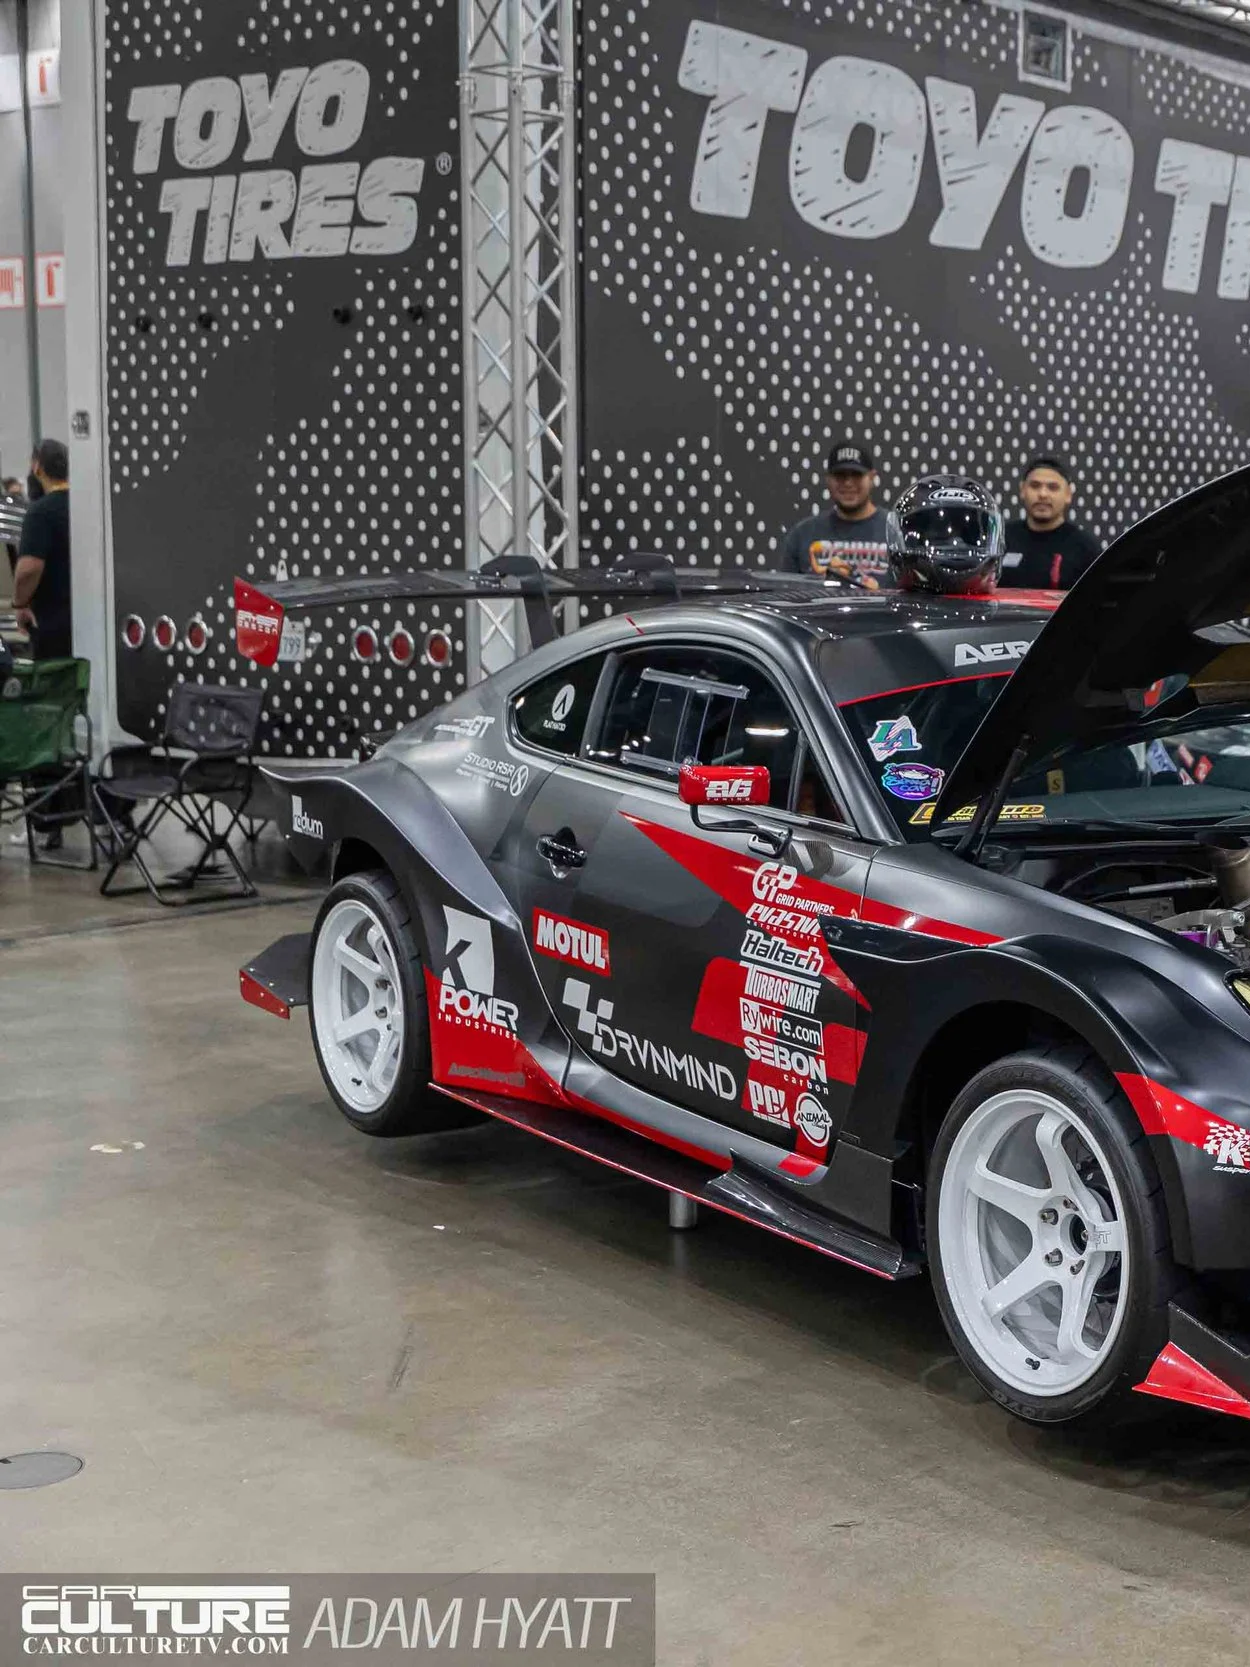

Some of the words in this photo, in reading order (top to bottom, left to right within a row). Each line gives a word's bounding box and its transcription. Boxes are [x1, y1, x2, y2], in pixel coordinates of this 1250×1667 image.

[126, 59, 371, 174] TOYO
[678, 20, 1134, 269] TOYO
[158, 157, 424, 267] TIRES
[937, 490, 972, 501] HJC
[464, 752, 496, 770] STUDIO
[496, 761, 516, 777] RSR
[776, 893, 795, 907] GRID
[794, 898, 835, 916] PARTNERS
[536, 914, 606, 970] MOTUL
[741, 929, 824, 977] Haltech
[439, 984, 519, 1032] POWER
[740, 960, 822, 1014] TURBOSMART
[438, 1013, 518, 1041] INDUSTRIES
[741, 1000, 822, 1047] Rywire.com
[597, 1021, 738, 1101] DRVNMIND
[783, 1074, 829, 1096] carbon
[796, 1112, 831, 1124] ANIMAL
